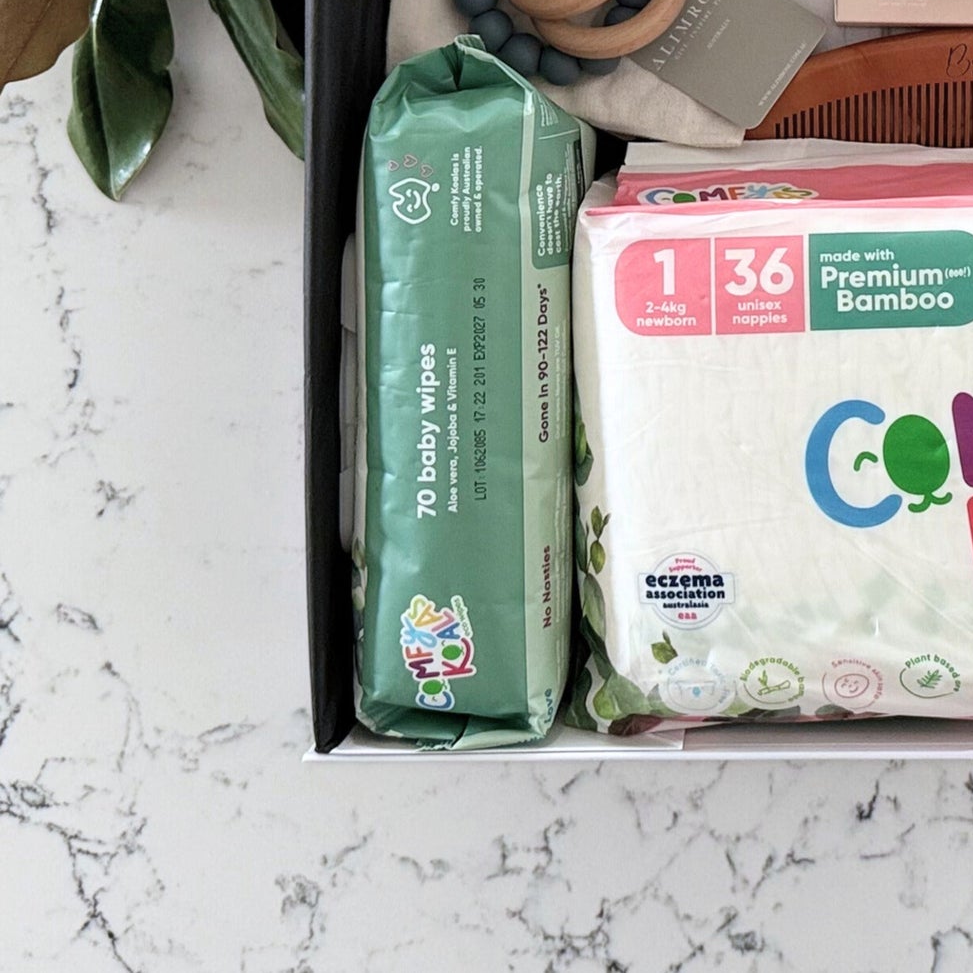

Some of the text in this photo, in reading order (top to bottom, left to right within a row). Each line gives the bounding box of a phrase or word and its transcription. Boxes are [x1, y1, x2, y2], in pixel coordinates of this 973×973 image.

[450, 152, 461, 227] Comfy Koalas is
[462, 146, 472, 232] proudly Australian
[474, 145, 484, 233] owned & operated.
[535, 184, 546, 257] Convenience
[545, 173, 555, 256] doesn't have to
[552, 209, 561, 228] the
[554, 230, 563, 254] cost
[819, 248, 895, 263] made with
[473, 277, 486, 291] 30
[653, 248, 677, 296] 1
[724, 247, 795, 296] 36
[820, 262, 944, 289] Premium
[473, 296, 486, 309] 05
[646, 300, 687, 316] 2-4kg
[737, 298, 782, 311] unisex
[836, 289, 955, 313] Bamboo
[636, 313, 697, 327] newborn
[732, 310, 788, 326] nappies
[473, 316, 487, 361] EXP2027
[537, 329, 549, 381] 90-122
[474, 366, 486, 386] 201
[538, 383, 549, 398] In
[474, 390, 487, 422] 17:22
[416, 342, 441, 519] 70 baby wipes
[446, 347, 460, 513] Aloe vera, Jojoba & Vitamin E
[538, 401, 550, 443] Gone
[541, 544, 552, 629] No Nasties
[645, 574, 725, 588] eczema
[645, 586, 725, 599] association
[662, 600, 710, 609] australasia
[677, 612, 698, 620] eaa
[408, 597, 474, 677] KOALAS
[402, 616, 452, 709] COMFY
[905, 653, 961, 679] Plant based
